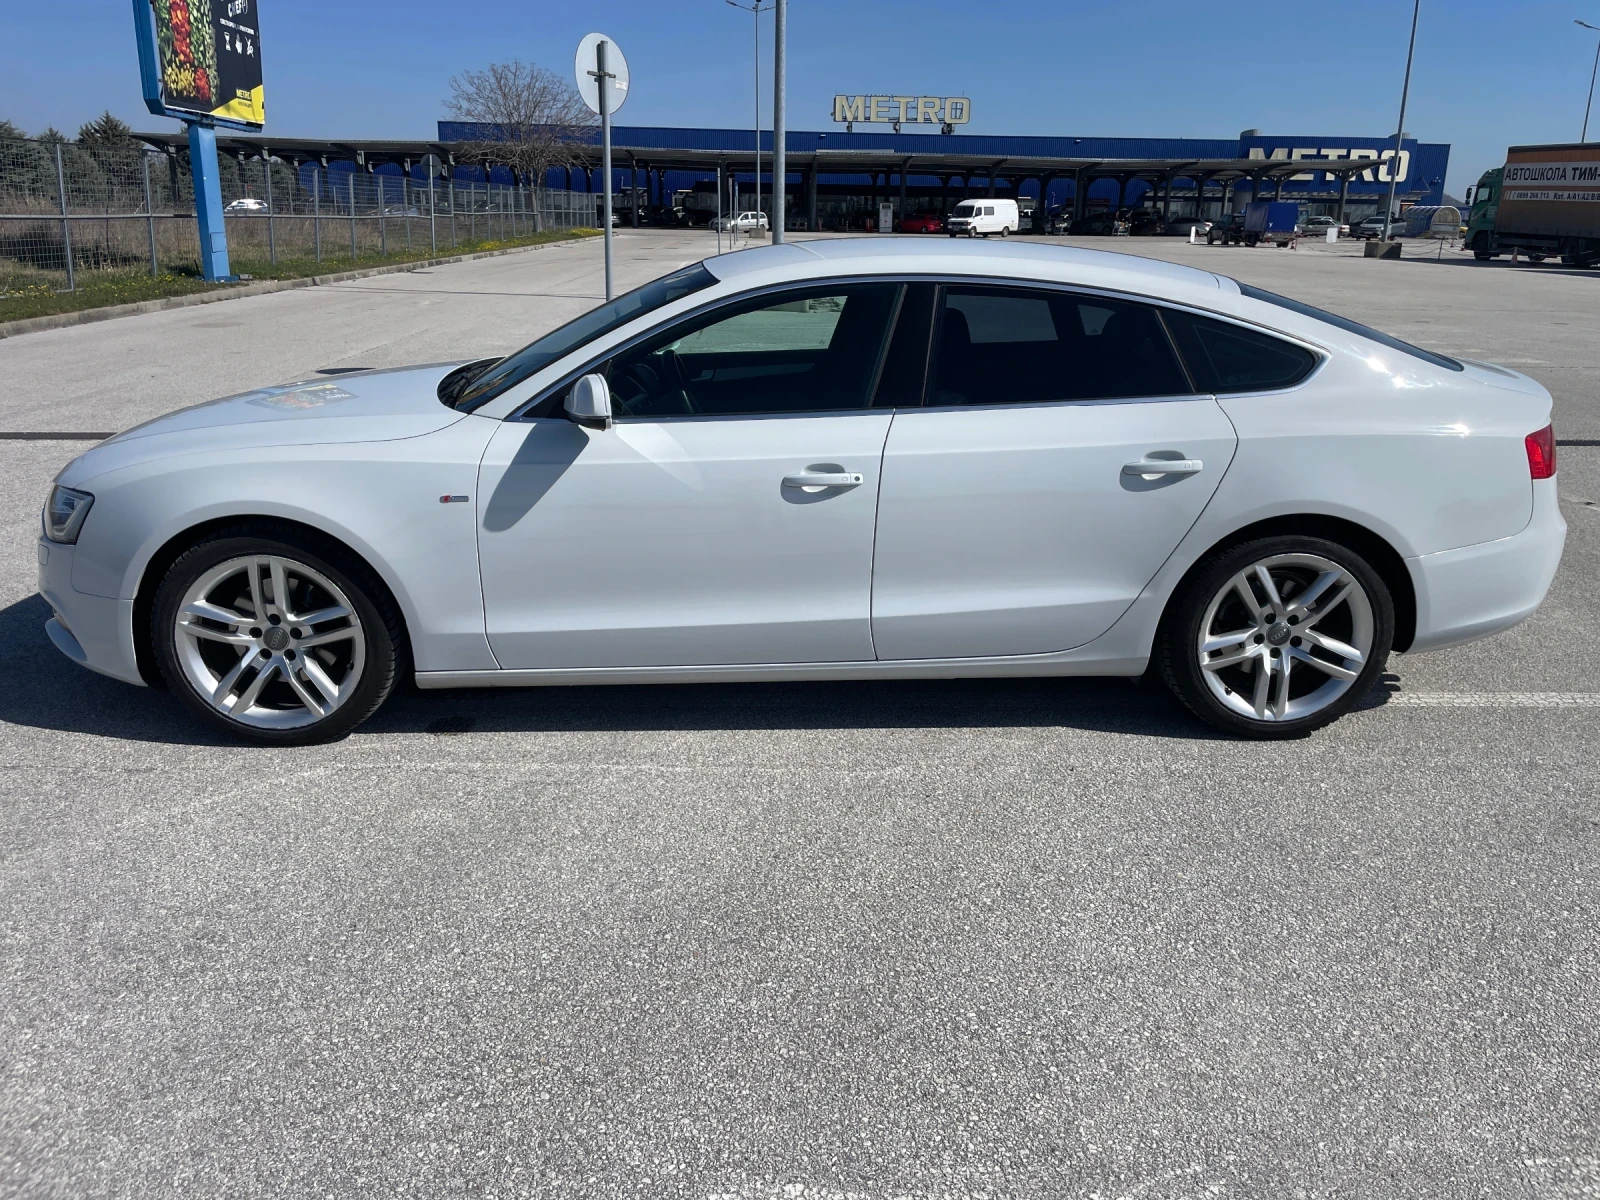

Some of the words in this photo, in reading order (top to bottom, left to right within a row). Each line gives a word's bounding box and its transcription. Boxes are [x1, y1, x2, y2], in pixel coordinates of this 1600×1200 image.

[236, 88, 251, 100] METRO
[834, 95, 971, 124] METRO
[1504, 167, 1567, 181] АВТОШКОЛА
